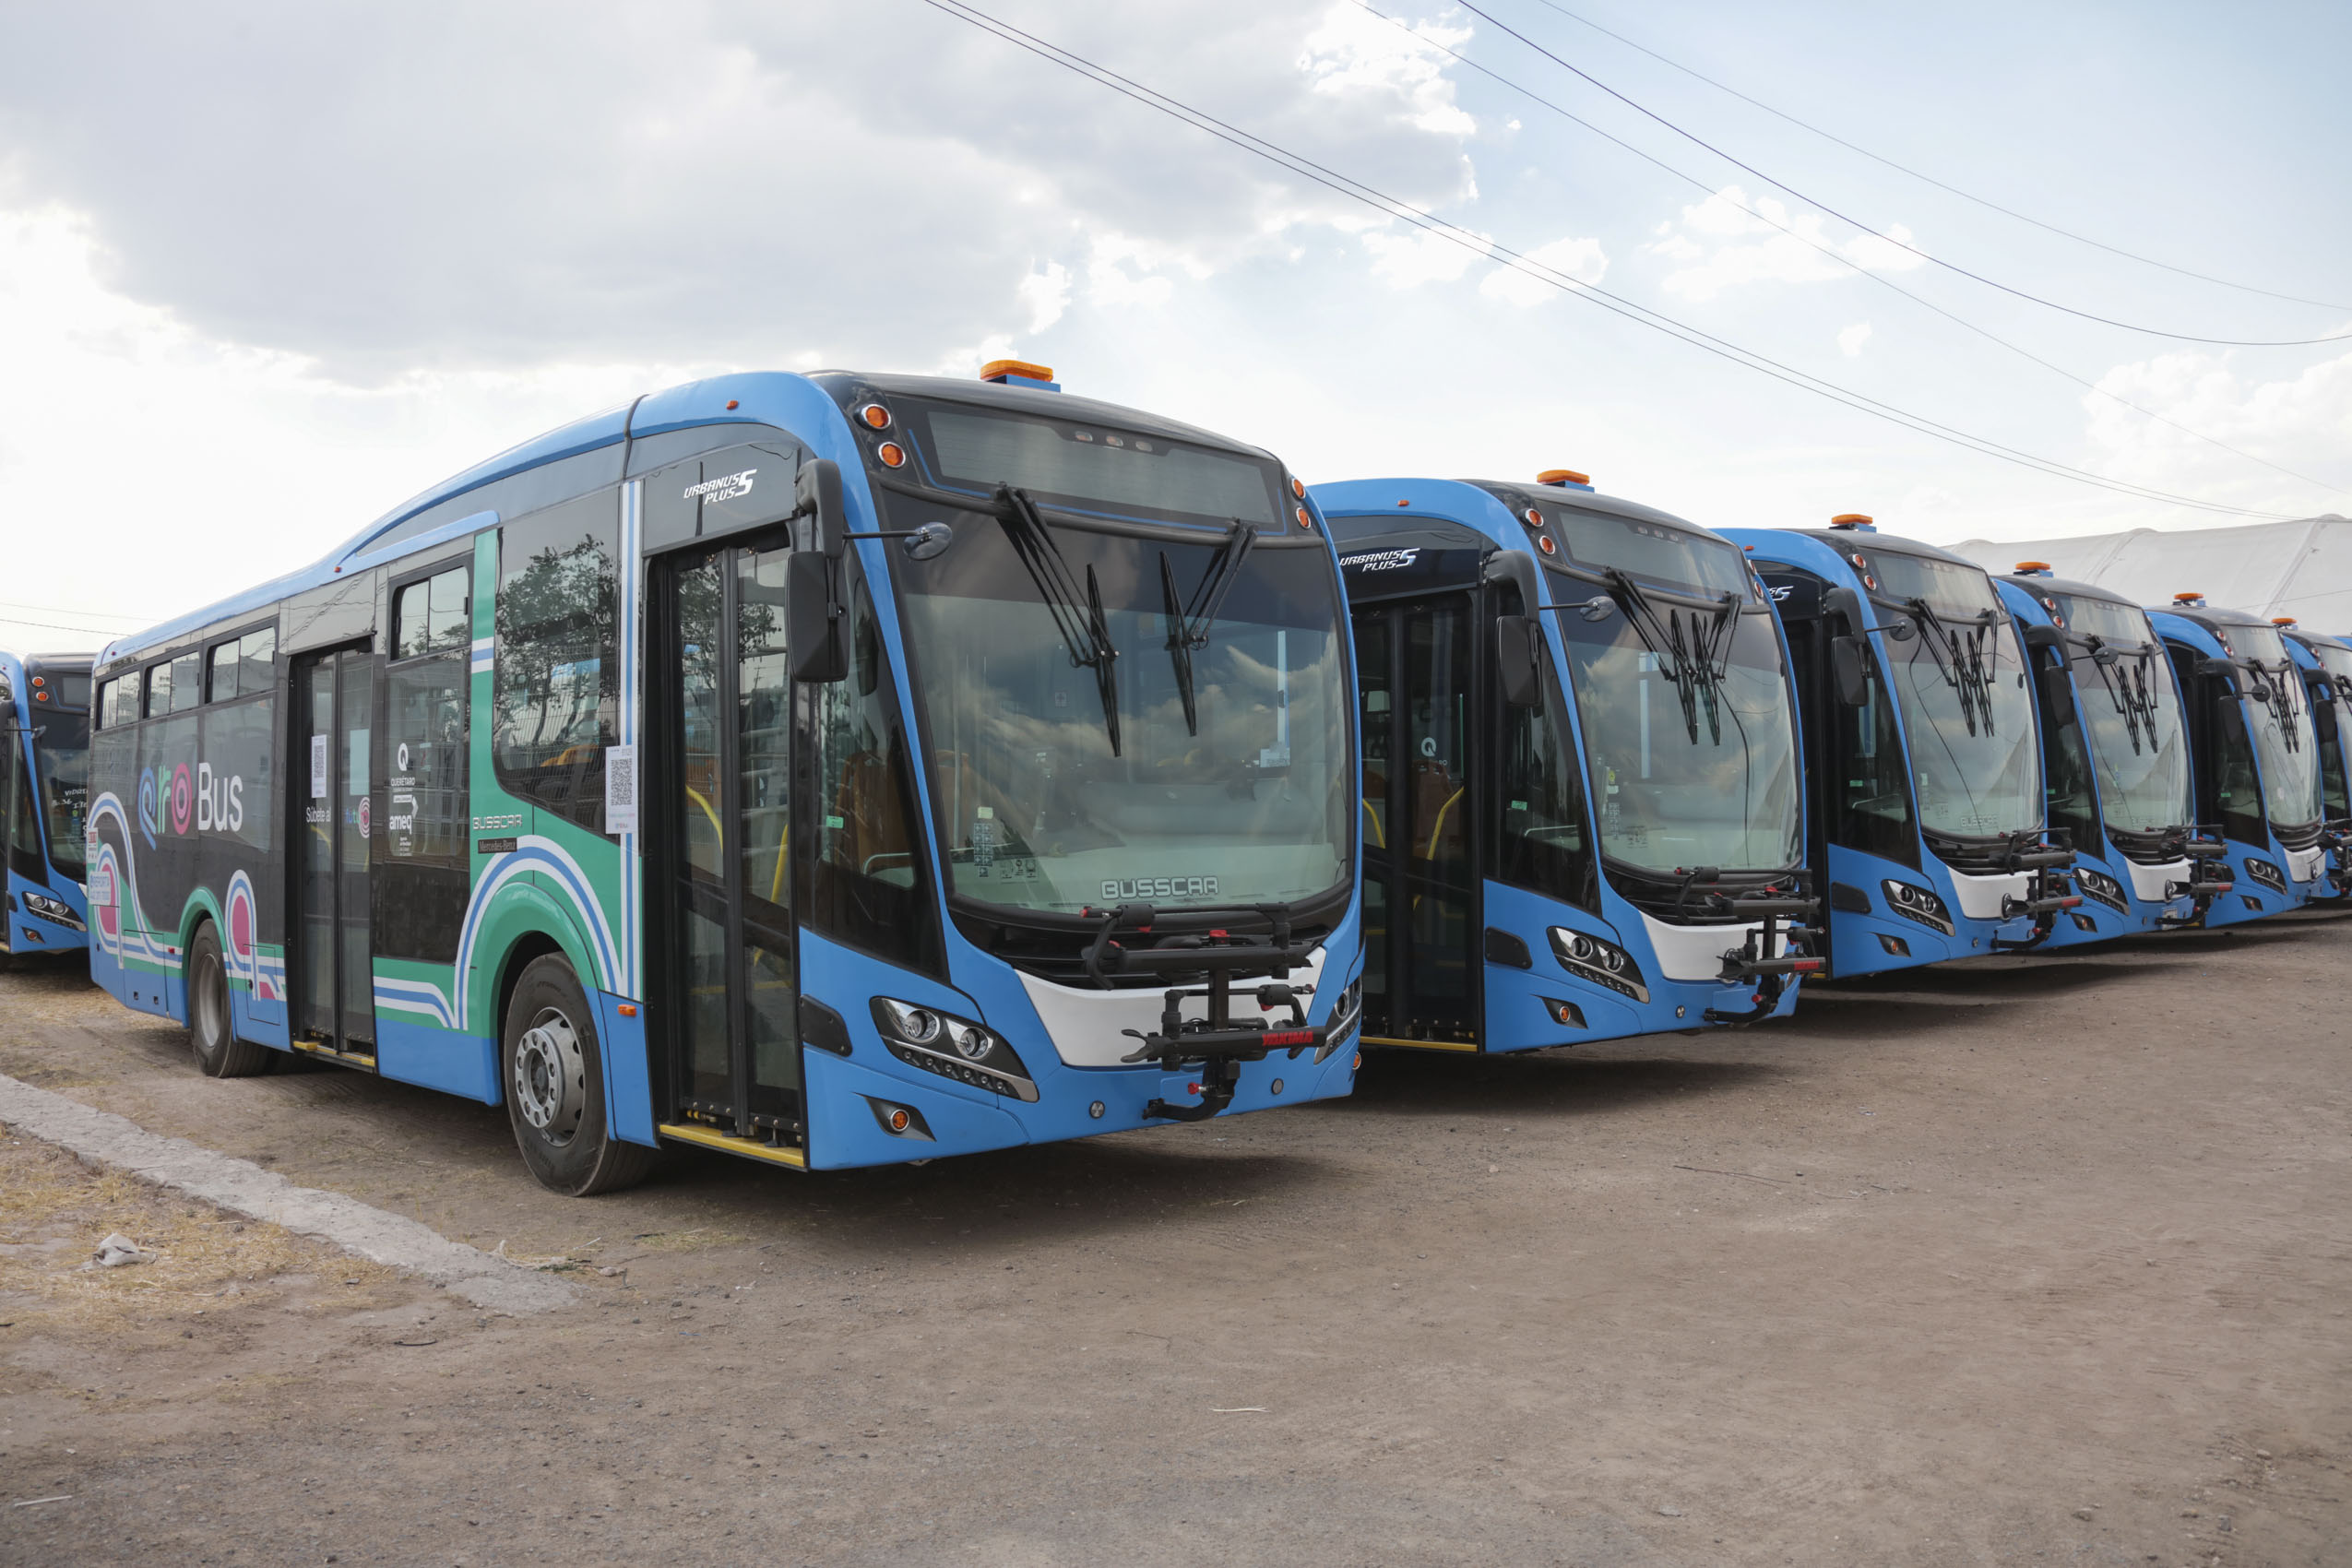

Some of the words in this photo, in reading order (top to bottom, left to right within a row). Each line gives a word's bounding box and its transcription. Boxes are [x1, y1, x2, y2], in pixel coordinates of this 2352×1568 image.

[197, 762, 243, 832] Bus
[389, 815, 412, 835] ameq
[472, 814, 523, 830] BUSSCAR
[1100, 875, 1219, 900] BUSSCAR
[1262, 1030, 1313, 1047] YAKIMA
